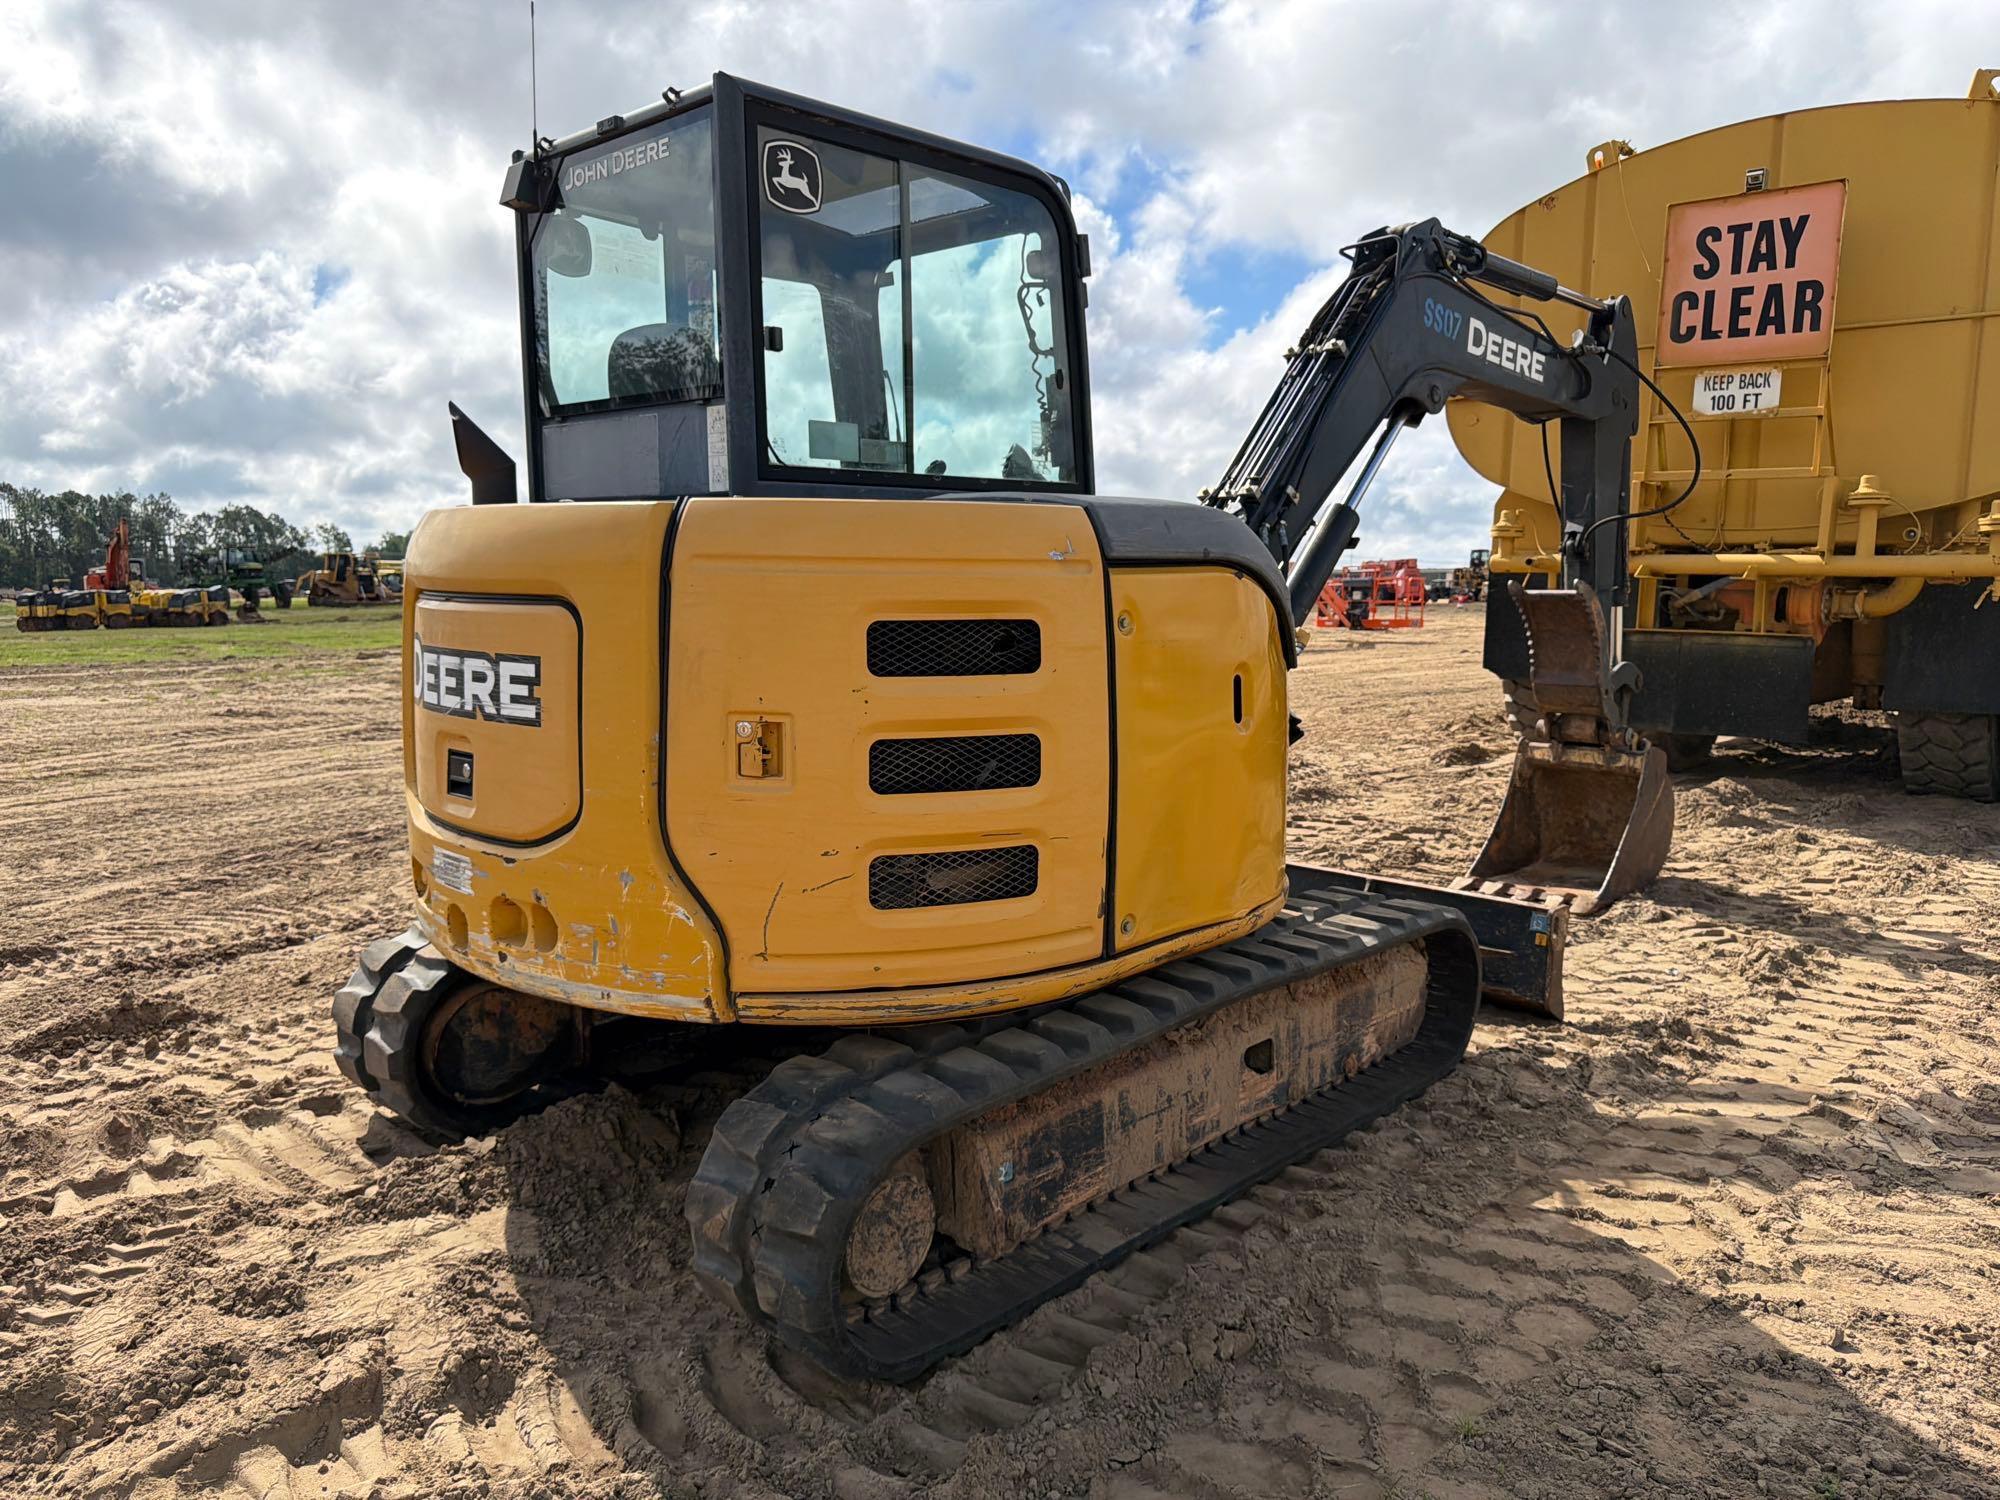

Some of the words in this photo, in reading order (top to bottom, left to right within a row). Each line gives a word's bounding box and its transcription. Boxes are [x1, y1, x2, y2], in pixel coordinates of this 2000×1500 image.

[565, 160, 608, 191] JOHN
[612, 137, 670, 175] DEERE
[1693, 214, 1811, 280] STAY
[1669, 279, 1824, 343] CLEAR
[1467, 316, 1546, 382] DEERE
[1703, 374, 1734, 392] KEEP
[1738, 372, 1772, 389] BACK
[1710, 394, 1735, 411] 100
[1742, 393, 1762, 409] FT
[414, 638, 537, 719] DEERE
